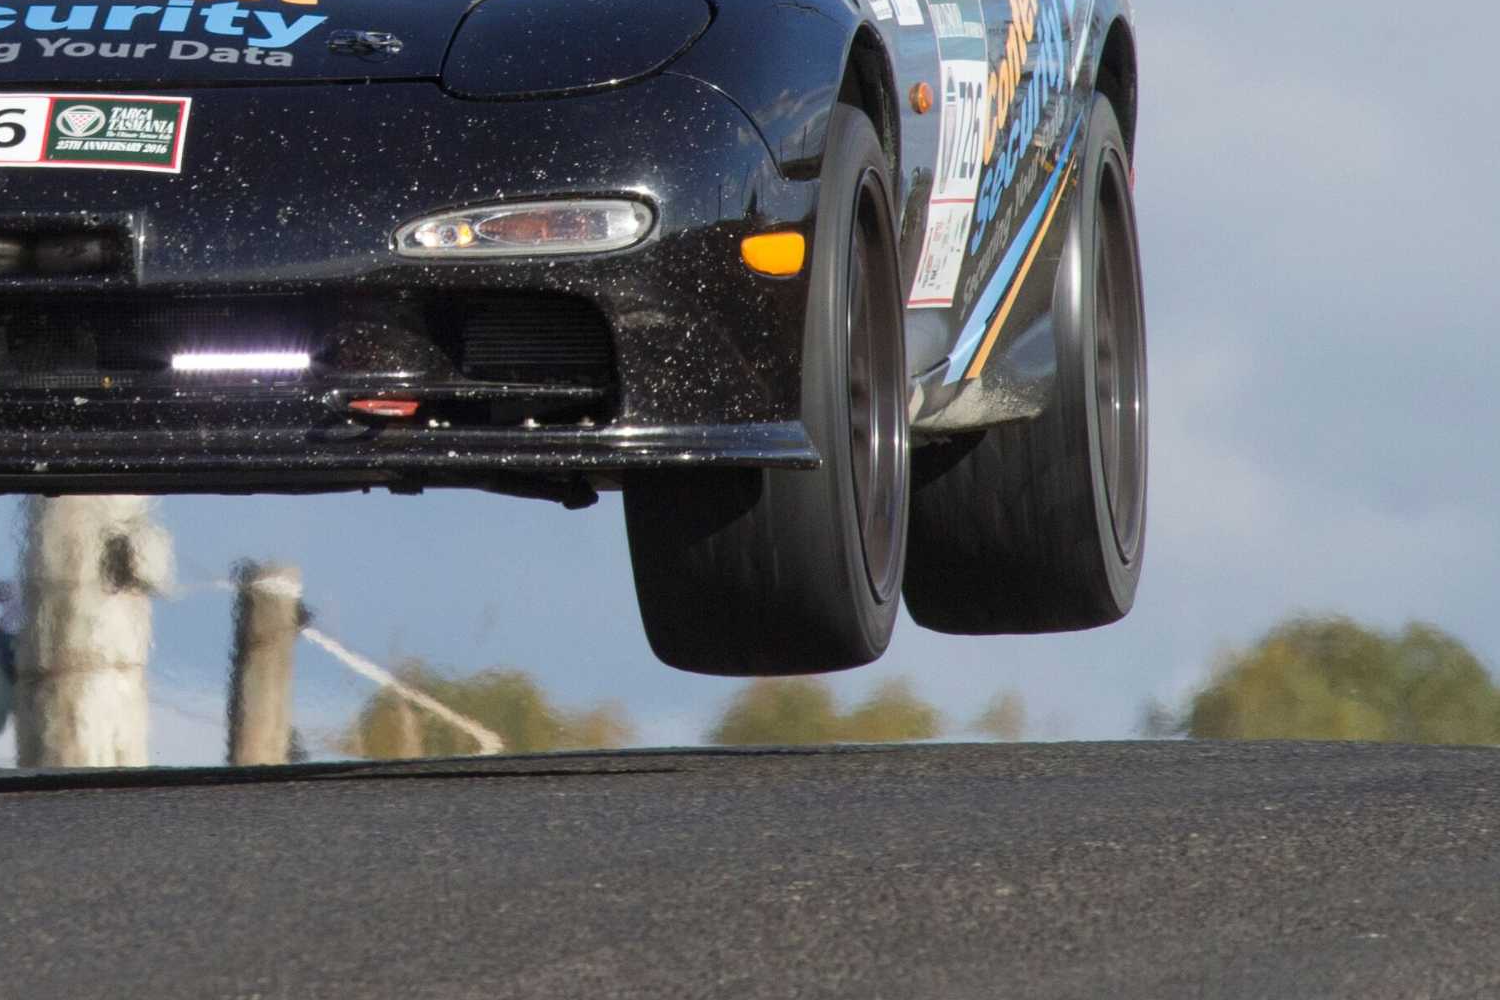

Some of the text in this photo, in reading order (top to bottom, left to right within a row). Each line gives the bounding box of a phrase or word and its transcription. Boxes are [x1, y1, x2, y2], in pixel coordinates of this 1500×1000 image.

[35, 37, 157, 59] Your
[168, 39, 295, 68] Data
[109, 106, 154, 121] TARGA
[107, 119, 176, 134] TASMANIA
[951, 81, 983, 180] 726
[54, 140, 168, 155] 25TH ANNIVERSARY 2016
